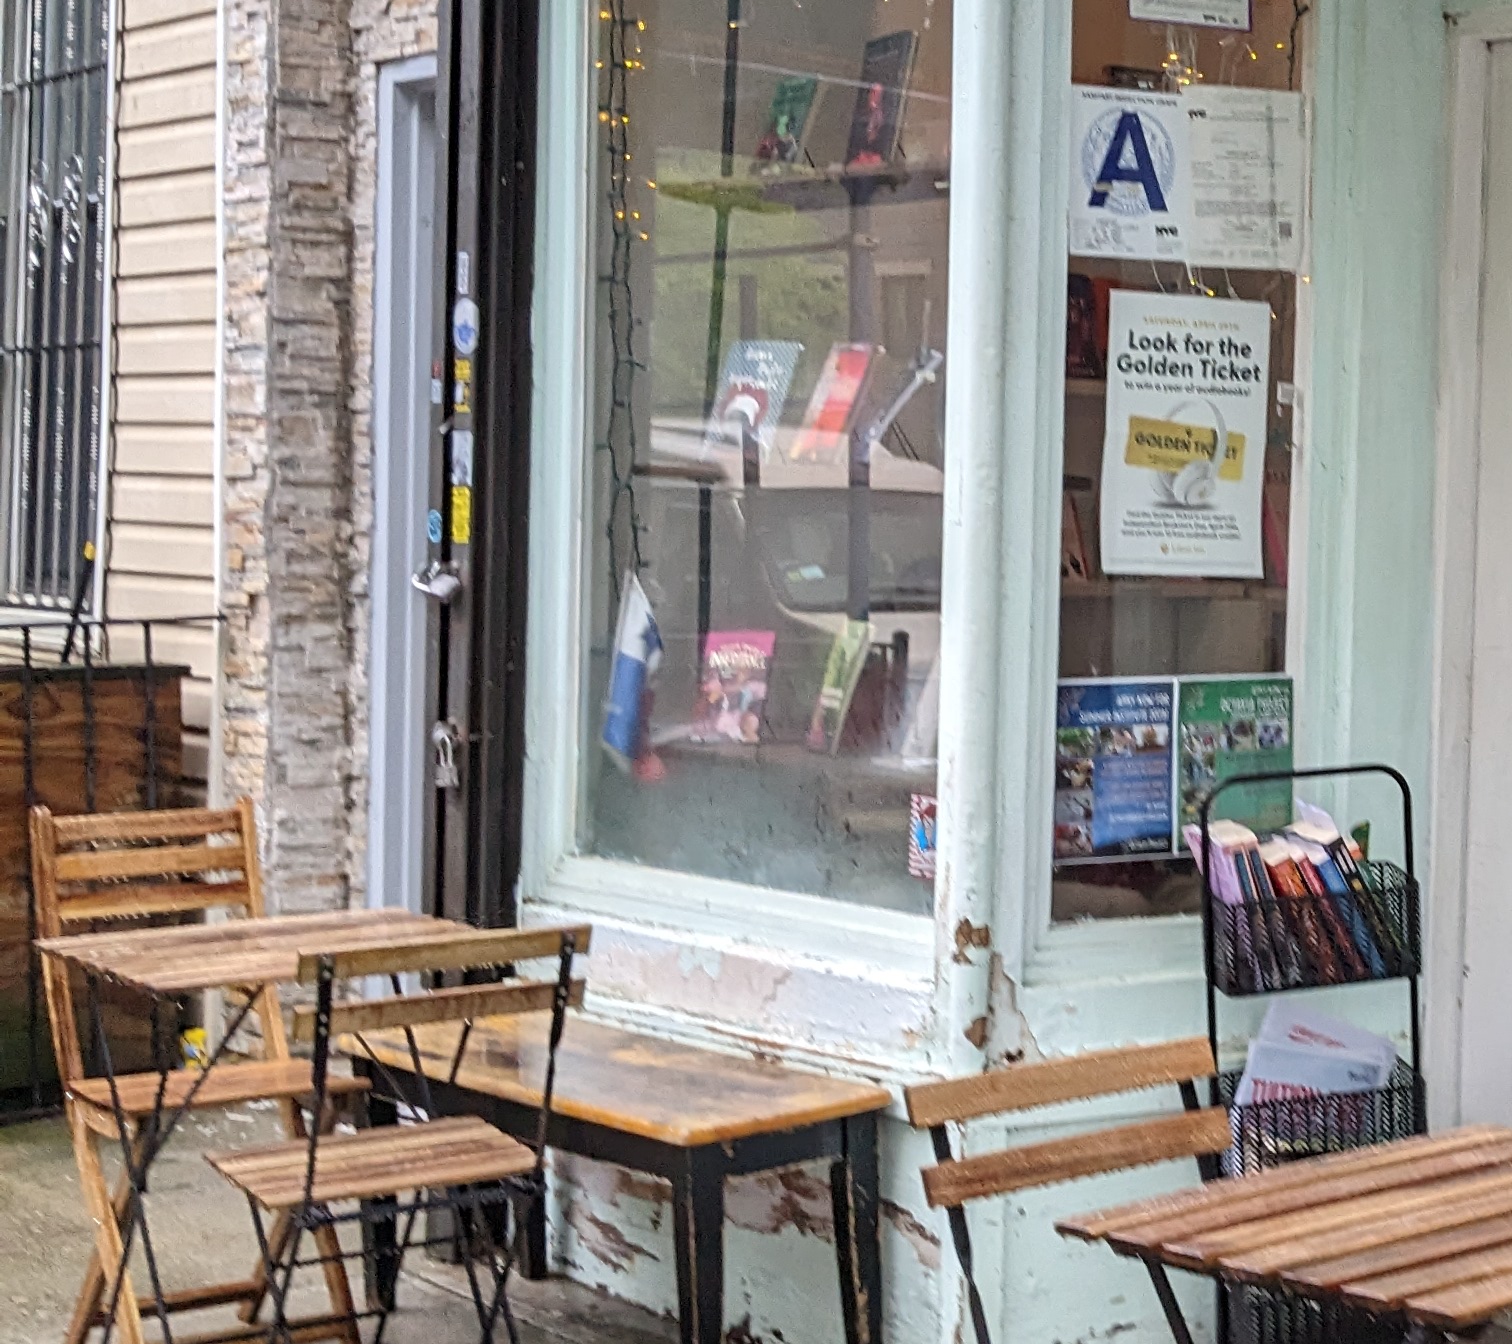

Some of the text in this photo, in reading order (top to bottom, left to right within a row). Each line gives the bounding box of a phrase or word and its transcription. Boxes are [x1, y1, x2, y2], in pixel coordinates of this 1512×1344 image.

[1088, 111, 1168, 212] A
[1128, 328, 1253, 359] Look for the
[1116, 353, 1262, 383] Golden Ticket
[1134, 431, 1191, 454] GOLDEN
